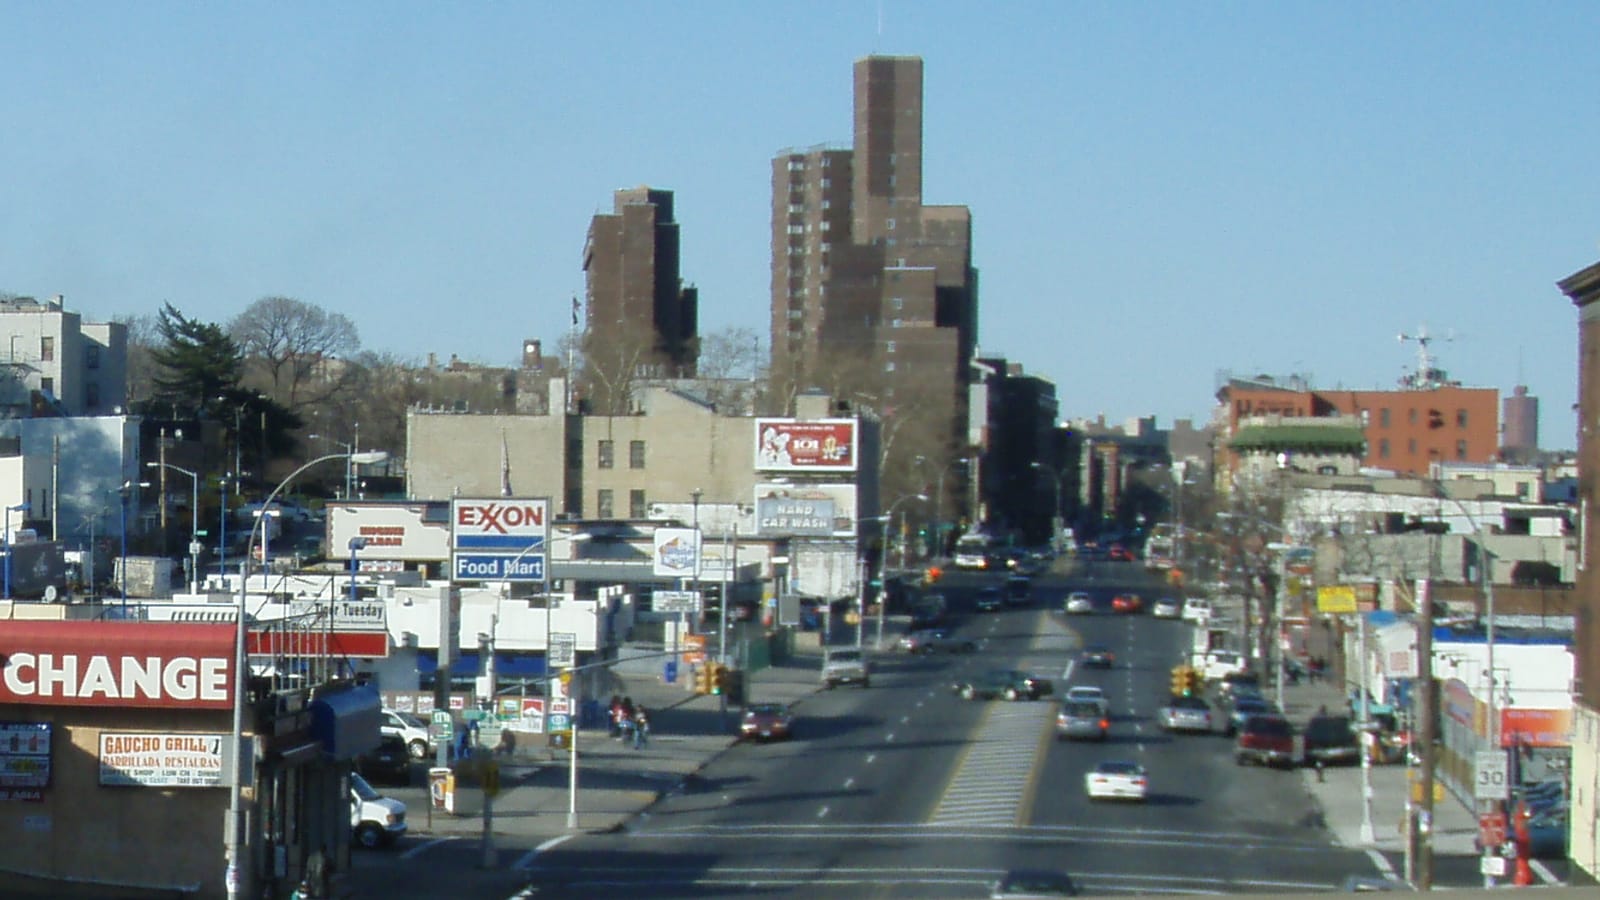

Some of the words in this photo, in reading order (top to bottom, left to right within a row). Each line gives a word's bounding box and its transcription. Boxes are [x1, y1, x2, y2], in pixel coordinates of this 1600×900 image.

[777, 504, 814, 515] HAND
[458, 503, 542, 534] EXXON
[761, 517, 788, 528] CAR
[791, 517, 828, 528] WASH
[458, 559, 498, 574] Food
[503, 559, 541, 574] Mart
[343, 602, 383, 620] Tuesday
[3, 652, 228, 700] CHANGE
[104, 736, 160, 754] GAUCHO
[165, 736, 207, 753] GRILL
[1478, 770, 1503, 786] 30
